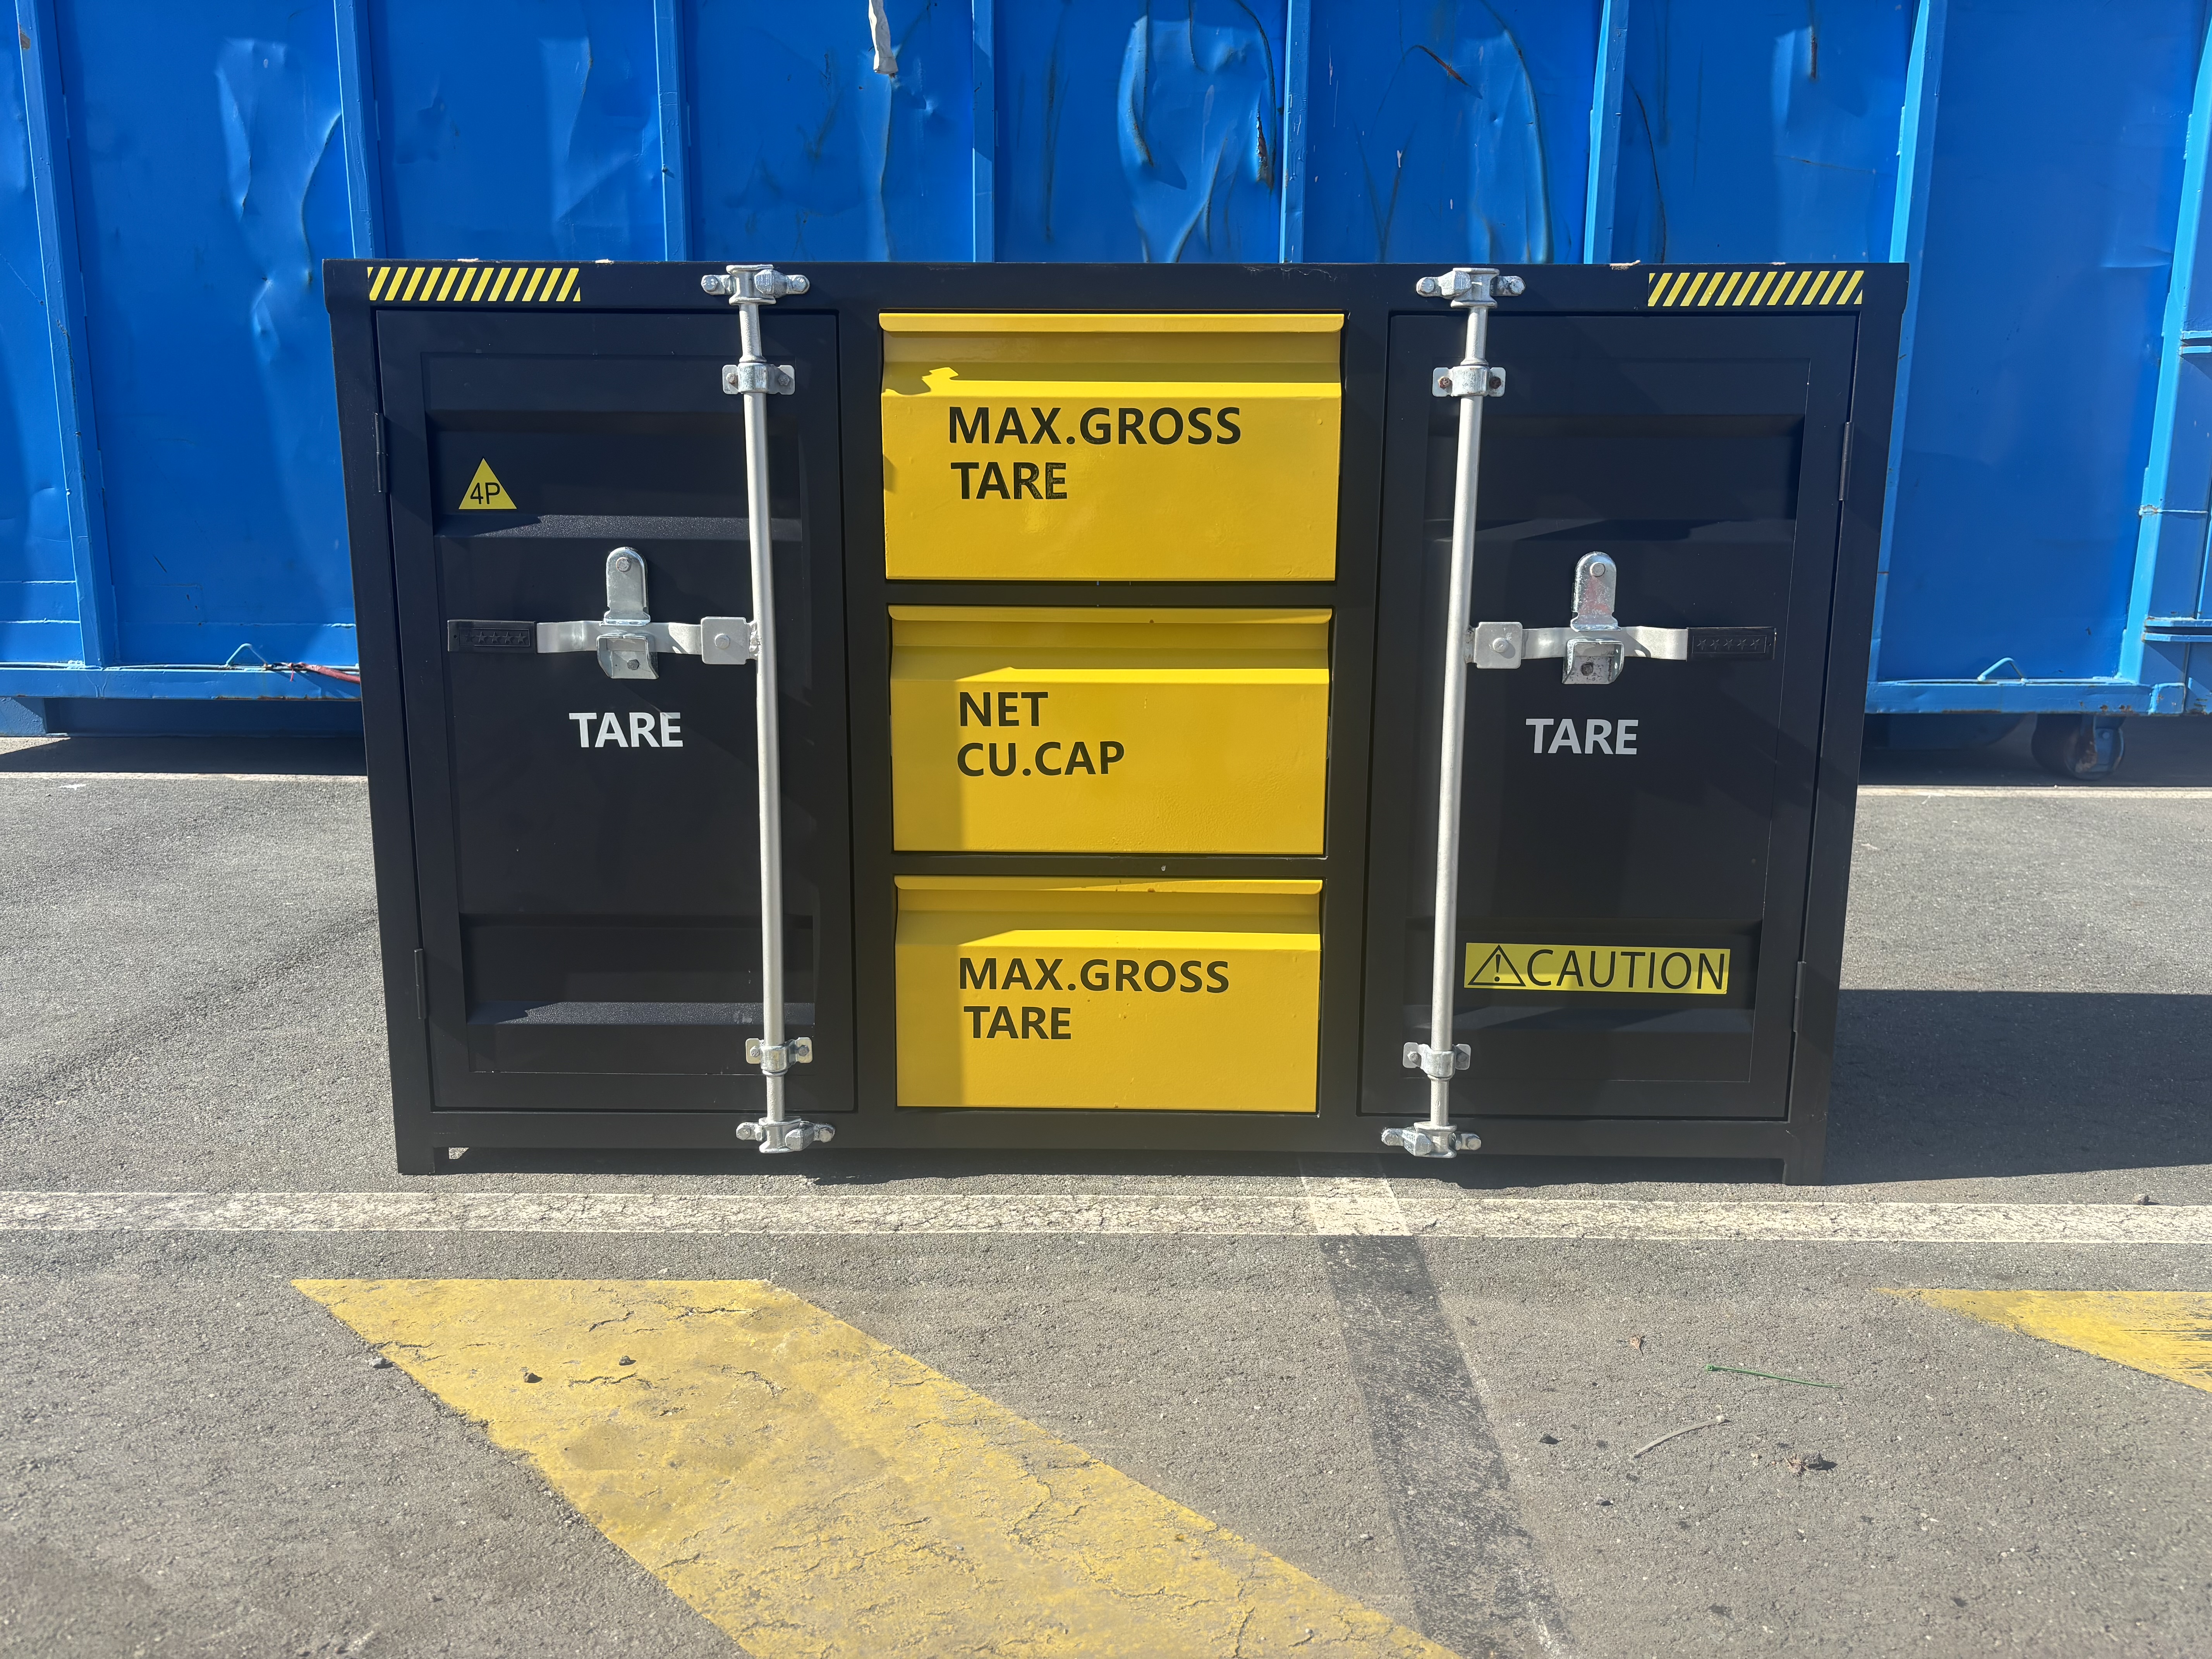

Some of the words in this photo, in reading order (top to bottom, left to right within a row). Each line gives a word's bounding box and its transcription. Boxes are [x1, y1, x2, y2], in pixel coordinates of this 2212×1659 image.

[949, 406, 1241, 445] MAX.GROSS
[470, 482, 500, 505] 4P
[950, 462, 1068, 500] TARE
[959, 692, 1049, 727] NET
[568, 712, 684, 748] TARE
[1525, 718, 1639, 755] TARE
[957, 741, 1125, 777] CU.CAP
[959, 957, 1229, 993] MAX.GROSS
[1527, 949, 1725, 990] CAUTION
[963, 1005, 1072, 1040] TARE
